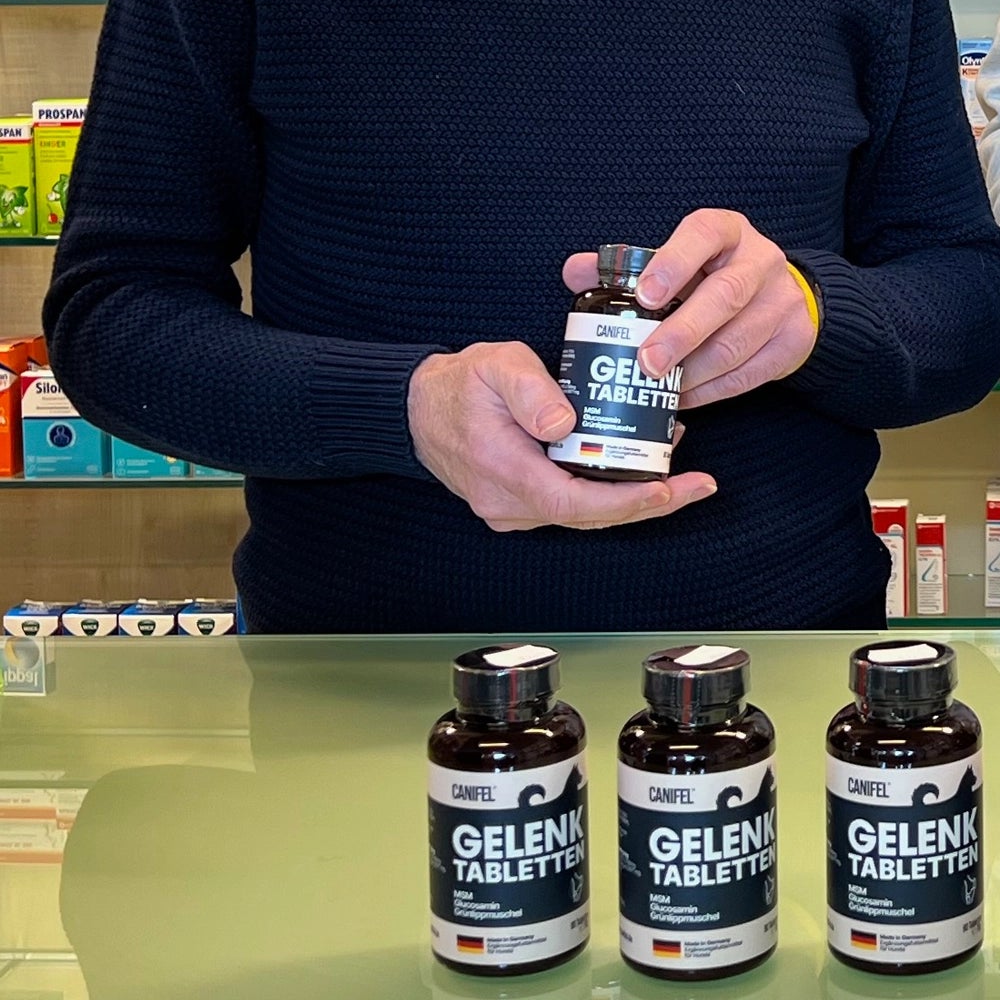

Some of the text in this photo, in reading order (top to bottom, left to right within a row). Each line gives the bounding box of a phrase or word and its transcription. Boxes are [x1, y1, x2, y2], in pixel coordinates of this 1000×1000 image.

[38, 108, 87, 120] PROSPAN
[596, 324, 631, 340] CANIFEL
[590, 355, 684, 393] GELNK
[35, 382, 62, 394] Silo
[452, 783, 496, 802] CANIFEL
[848, 777, 890, 798] CANIFEL
[649, 786, 694, 805] CANIFEL
[452, 804, 584, 860] GELENK
[649, 806, 775, 863] GELENK
[847, 807, 978, 857] GELENK
[452, 840, 585, 884] TABLETTEN
[649, 841, 776, 888] TABLETTEN
[848, 842, 979, 881] TABLETTEN
[453, 890, 474, 900] MSM
[848, 884, 867, 896] MSM
[453, 899, 500, 910] Glucosamin
[650, 893, 671, 904] MSM
[848, 893, 893, 907] Glucosamin
[453, 908, 523, 921] Grünlippmuschel
[650, 902, 698, 914] Glucosamin
[848, 903, 915, 917] Grünlippmuschel
[650, 911, 721, 925] Grünlippmuschel
